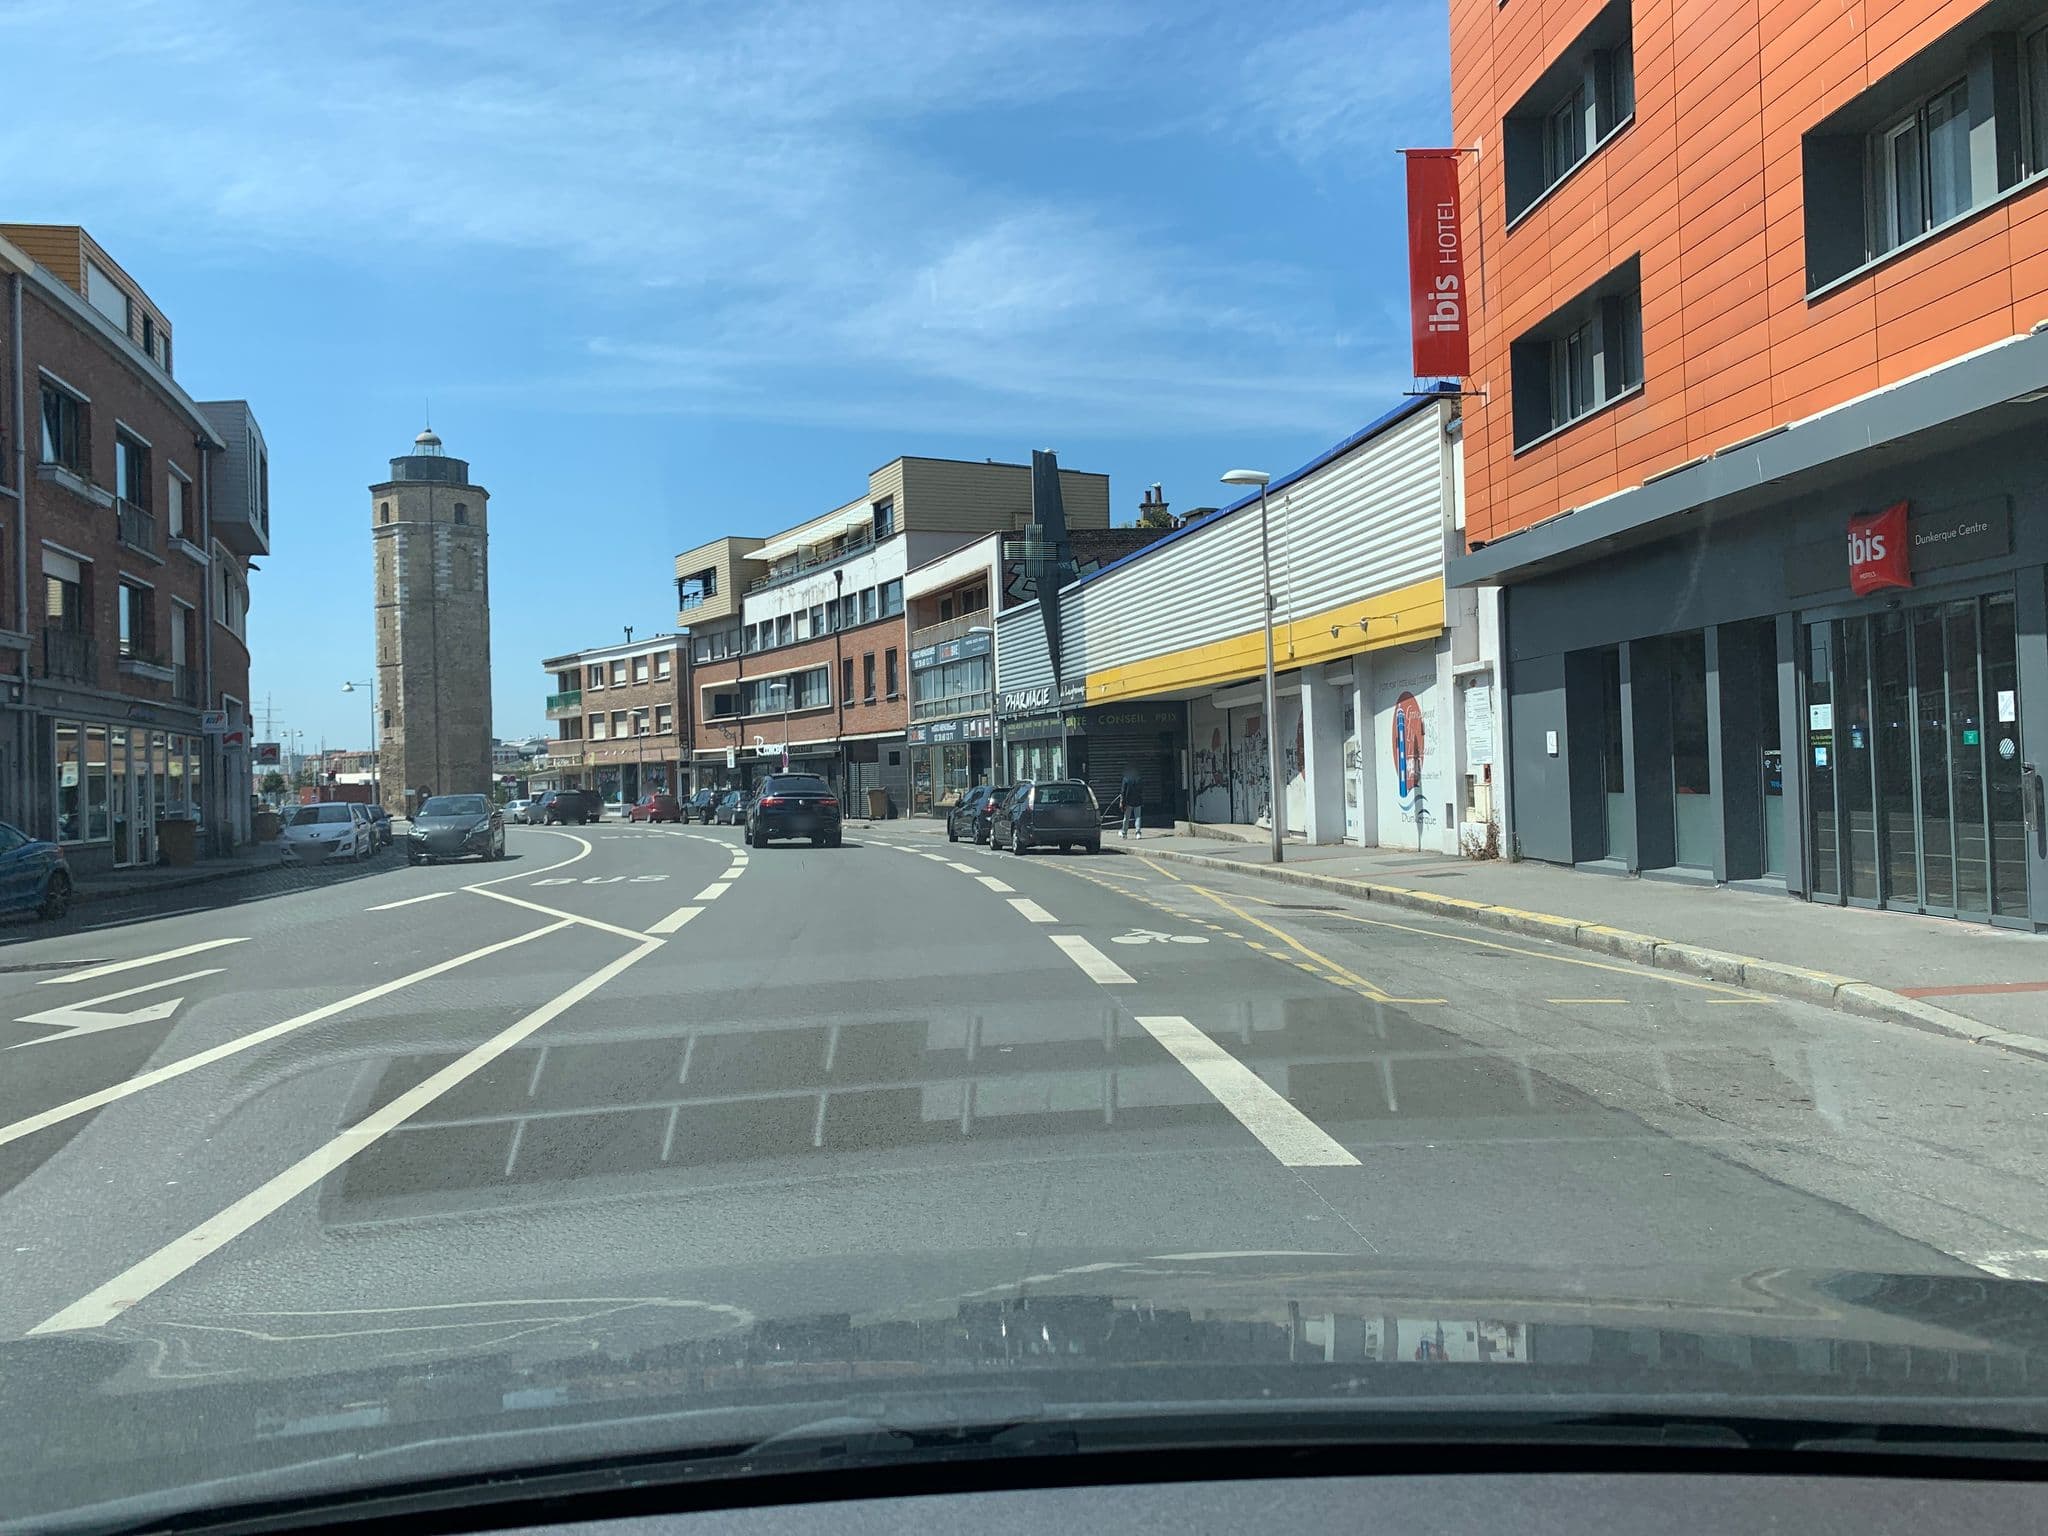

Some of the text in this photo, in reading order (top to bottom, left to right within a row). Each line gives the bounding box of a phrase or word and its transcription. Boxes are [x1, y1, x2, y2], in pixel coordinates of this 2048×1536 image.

[1429, 196, 1460, 332] ibis HOTEL
[1915, 522, 1988, 546] Dunkerque Centre
[1848, 528, 1886, 566] ibis
[1005, 687, 1050, 712] PHARMACIE
[1098, 713, 1146, 726] CONSEIL
